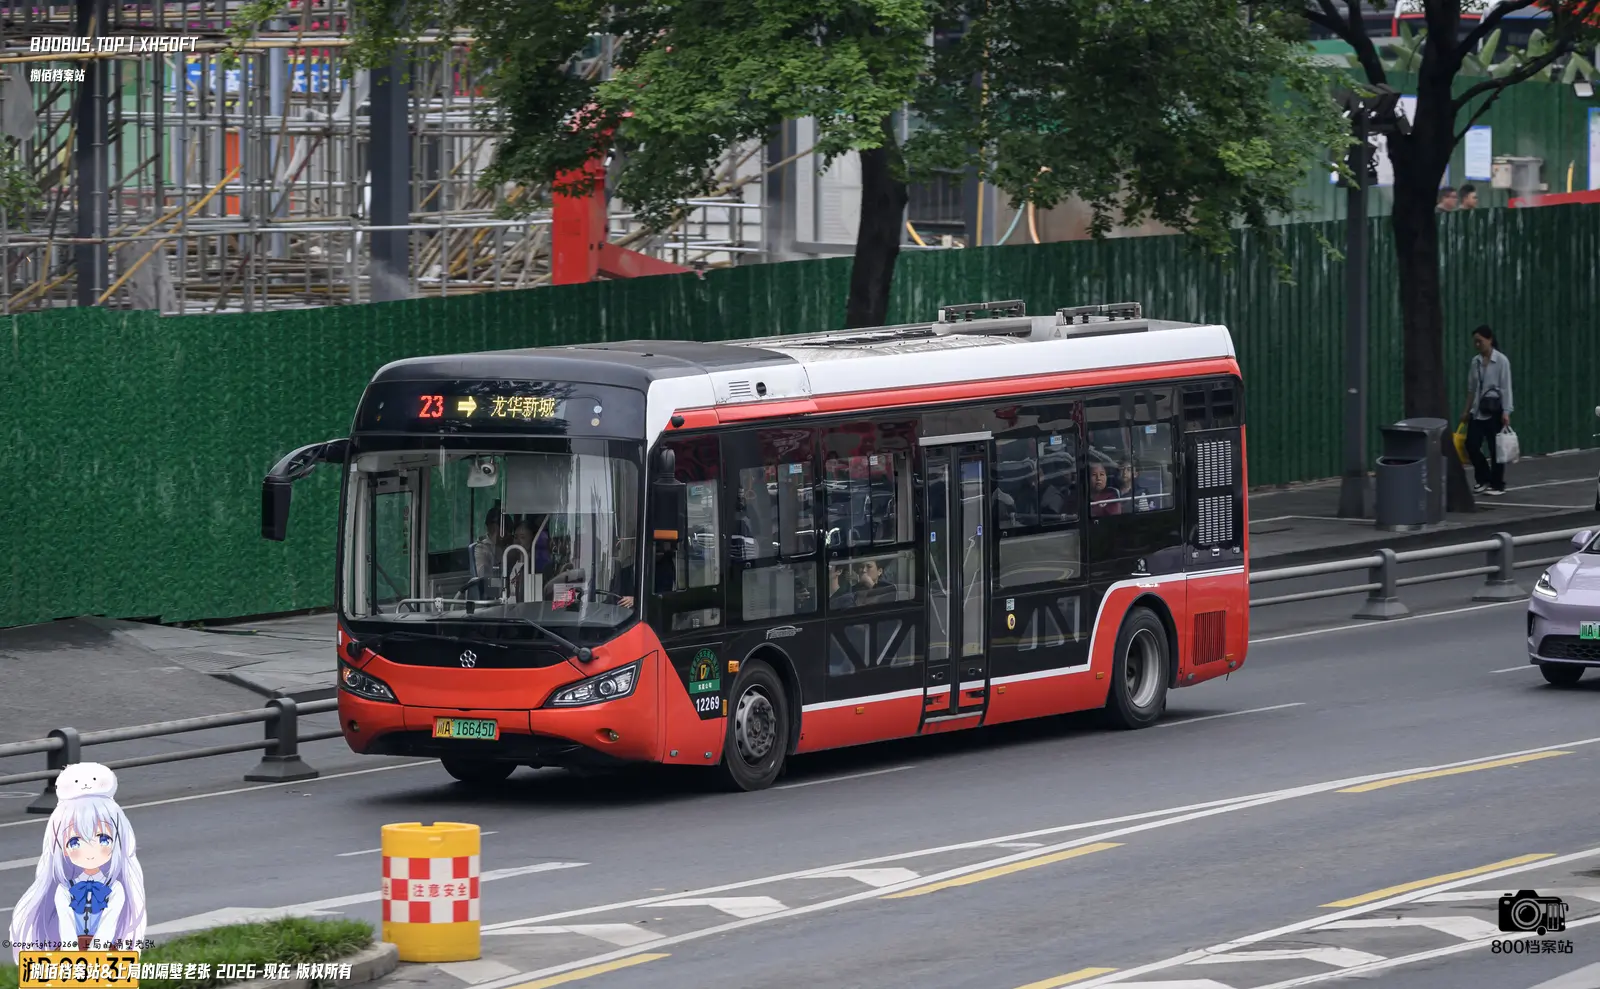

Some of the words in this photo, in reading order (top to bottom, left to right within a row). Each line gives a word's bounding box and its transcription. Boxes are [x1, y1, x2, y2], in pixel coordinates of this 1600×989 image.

[418, 395, 444, 418] 23
[490, 396, 556, 418] 龙华新城
[695, 696, 720, 713] 12269
[413, 883, 467, 897] 注意安全
